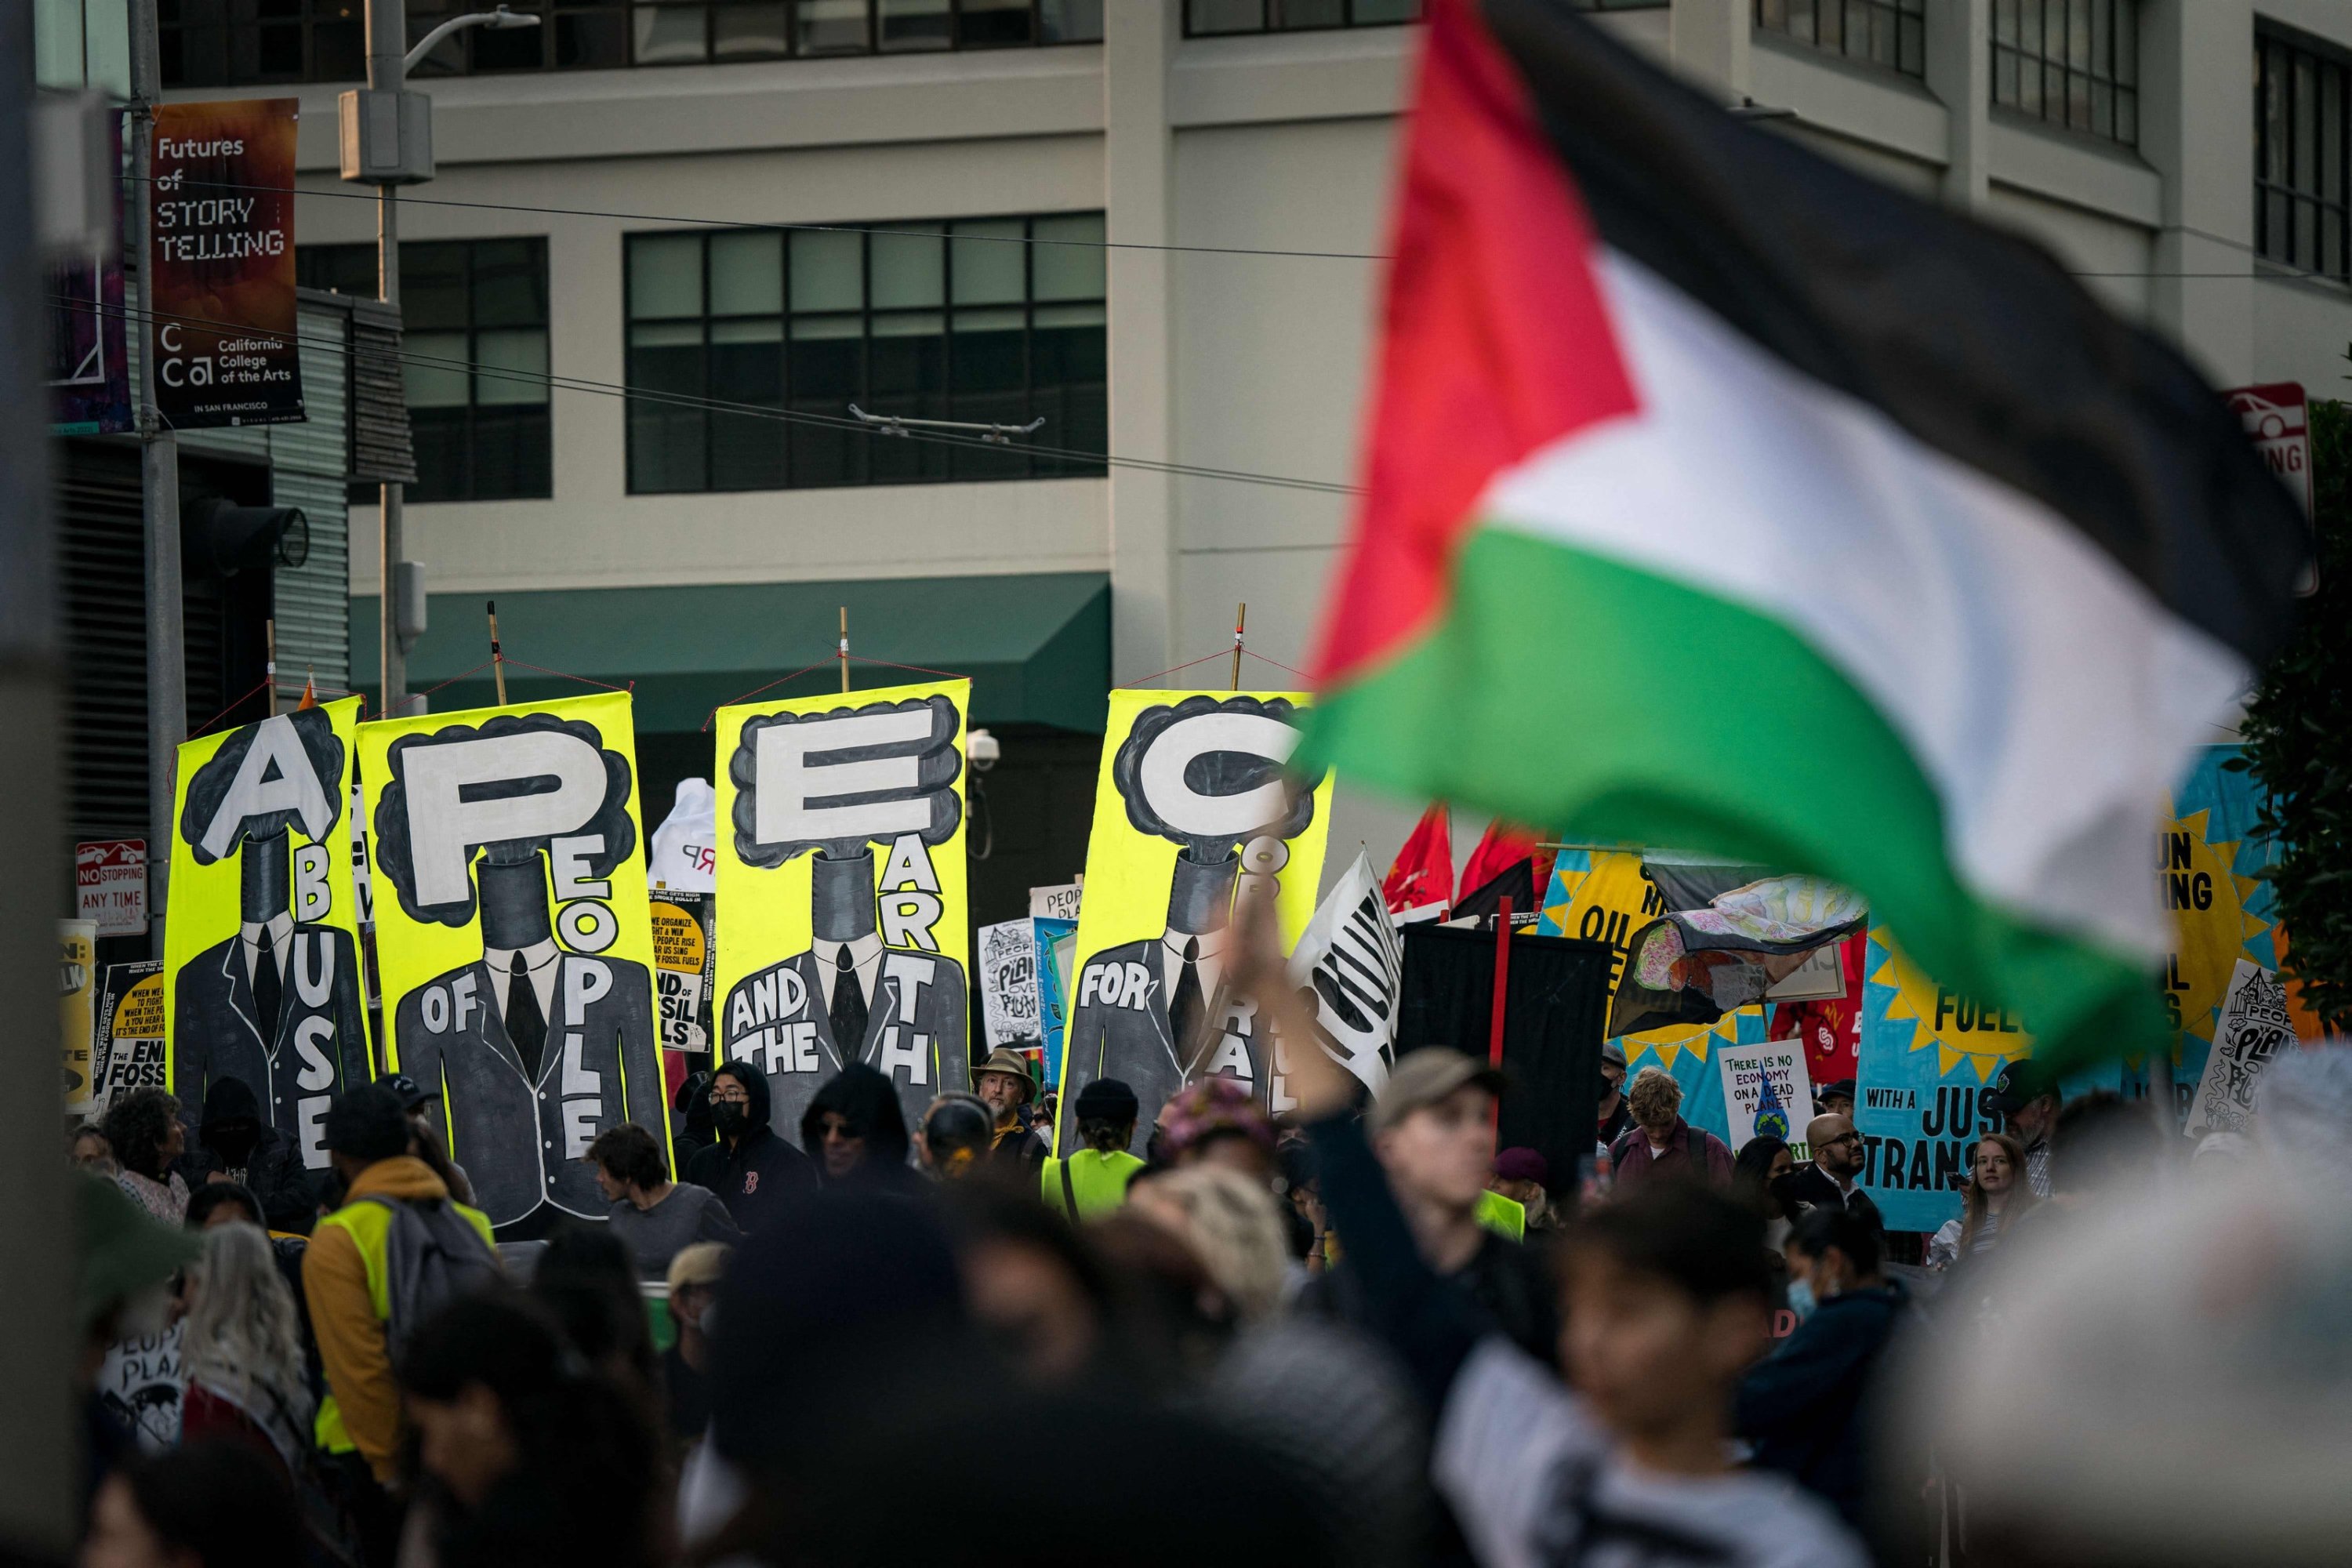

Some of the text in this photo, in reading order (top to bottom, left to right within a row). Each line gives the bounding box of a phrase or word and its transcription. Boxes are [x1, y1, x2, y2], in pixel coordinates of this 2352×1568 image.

[158, 138, 244, 159] Futures
[157, 169, 183, 191] of
[158, 197, 254, 227] STORY
[158, 230, 284, 261] TELLING
[161, 323, 182, 351] C
[219, 337, 283, 352] California
[220, 354, 267, 370] College
[221, 369, 291, 383] of the Arts
[223, 401, 268, 412] FRANCISCO
[80, 868, 143, 883] NO STOPPING
[82, 891, 141, 909] ANY TIME
[661, 917, 691, 927] ORGANIZE
[1580, 905, 1631, 955] OIL
[671, 927, 684, 936] WIN
[657, 935, 679, 946] PEOPLE
[682, 937, 695, 947] RISE
[664, 946, 672, 955] US
[673, 946, 688, 956] SING
[662, 956, 681, 965] FOSSIL
[682, 956, 699, 966] FUELS
[132, 989, 150, 998] WHEN
[152, 988, 161, 996] WE
[682, 989, 691, 997] OF
[1080, 961, 1152, 1011] FOR
[147, 996, 163, 1006] FIGHT
[421, 972, 477, 1035] OF
[731, 967, 808, 1036] AND
[125, 1007, 144, 1017] WHEN
[144, 1006, 154, 1014] THE
[659, 996, 695, 1023] SIL
[145, 1016, 160, 1025] HEAR
[116, 1028, 127, 1036] IT'S
[139, 1025, 150, 1034] END
[132, 1040, 165, 1062] EN
[730, 1021, 819, 1076] THE
[1725, 1055, 1792, 1072] THERE IS NO
[1736, 1069, 1789, 1085] ECONOMY
[1734, 1083, 1794, 1100] ON A DEAD
[1866, 1087, 1915, 1109] WITH A
[1745, 1097, 1792, 1114] PLANET
[1617, 1125, 1628, 1140] ONY
[742, 1171, 760, 1193] B
